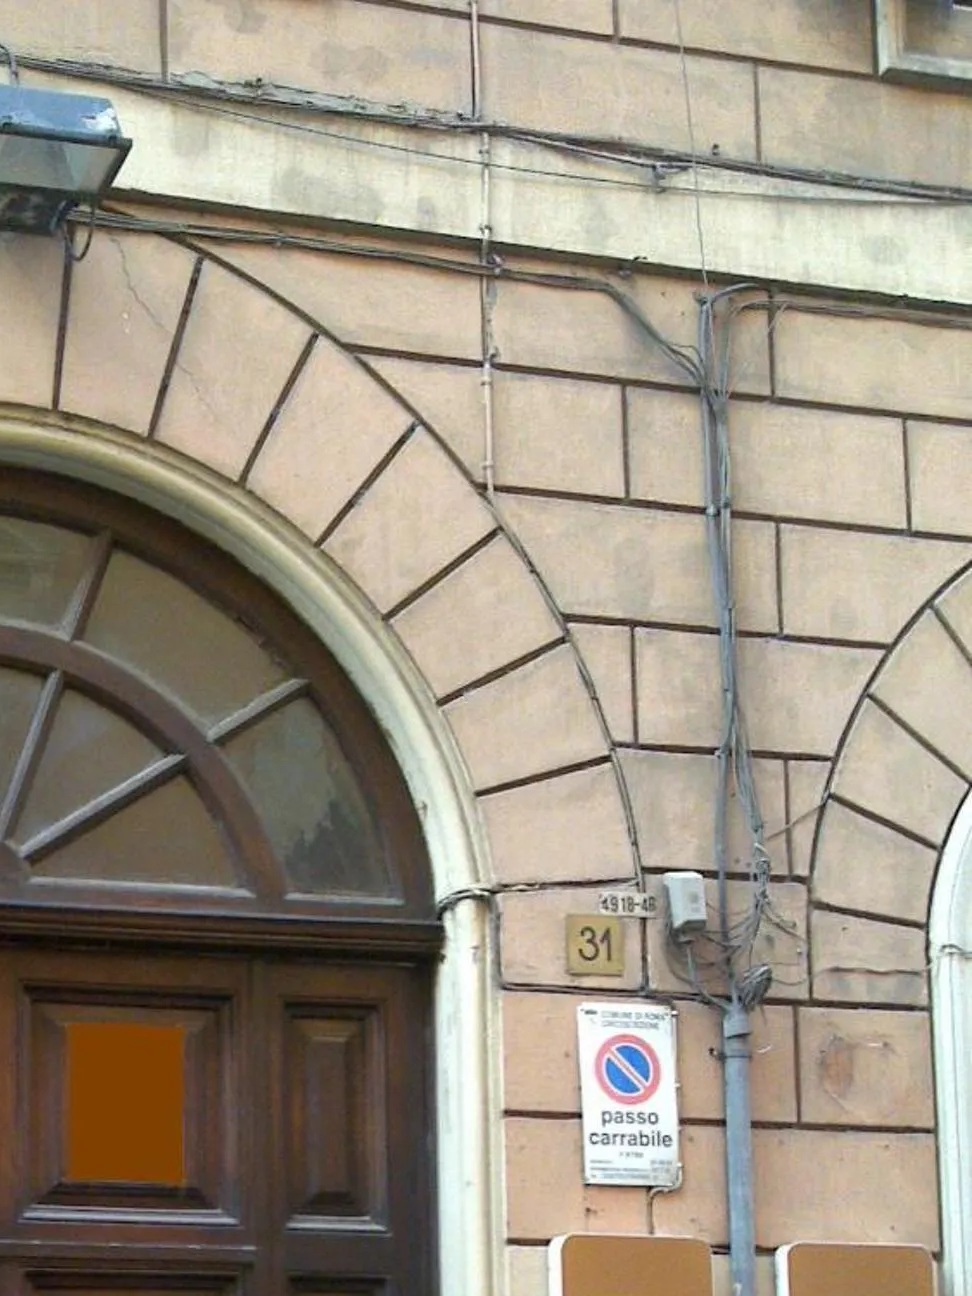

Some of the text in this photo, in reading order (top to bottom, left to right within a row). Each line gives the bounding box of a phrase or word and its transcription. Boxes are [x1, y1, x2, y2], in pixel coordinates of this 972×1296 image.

[578, 926, 612, 962] 31
[601, 1110, 659, 1128] passo
[589, 1130, 673, 1148] carrabile
